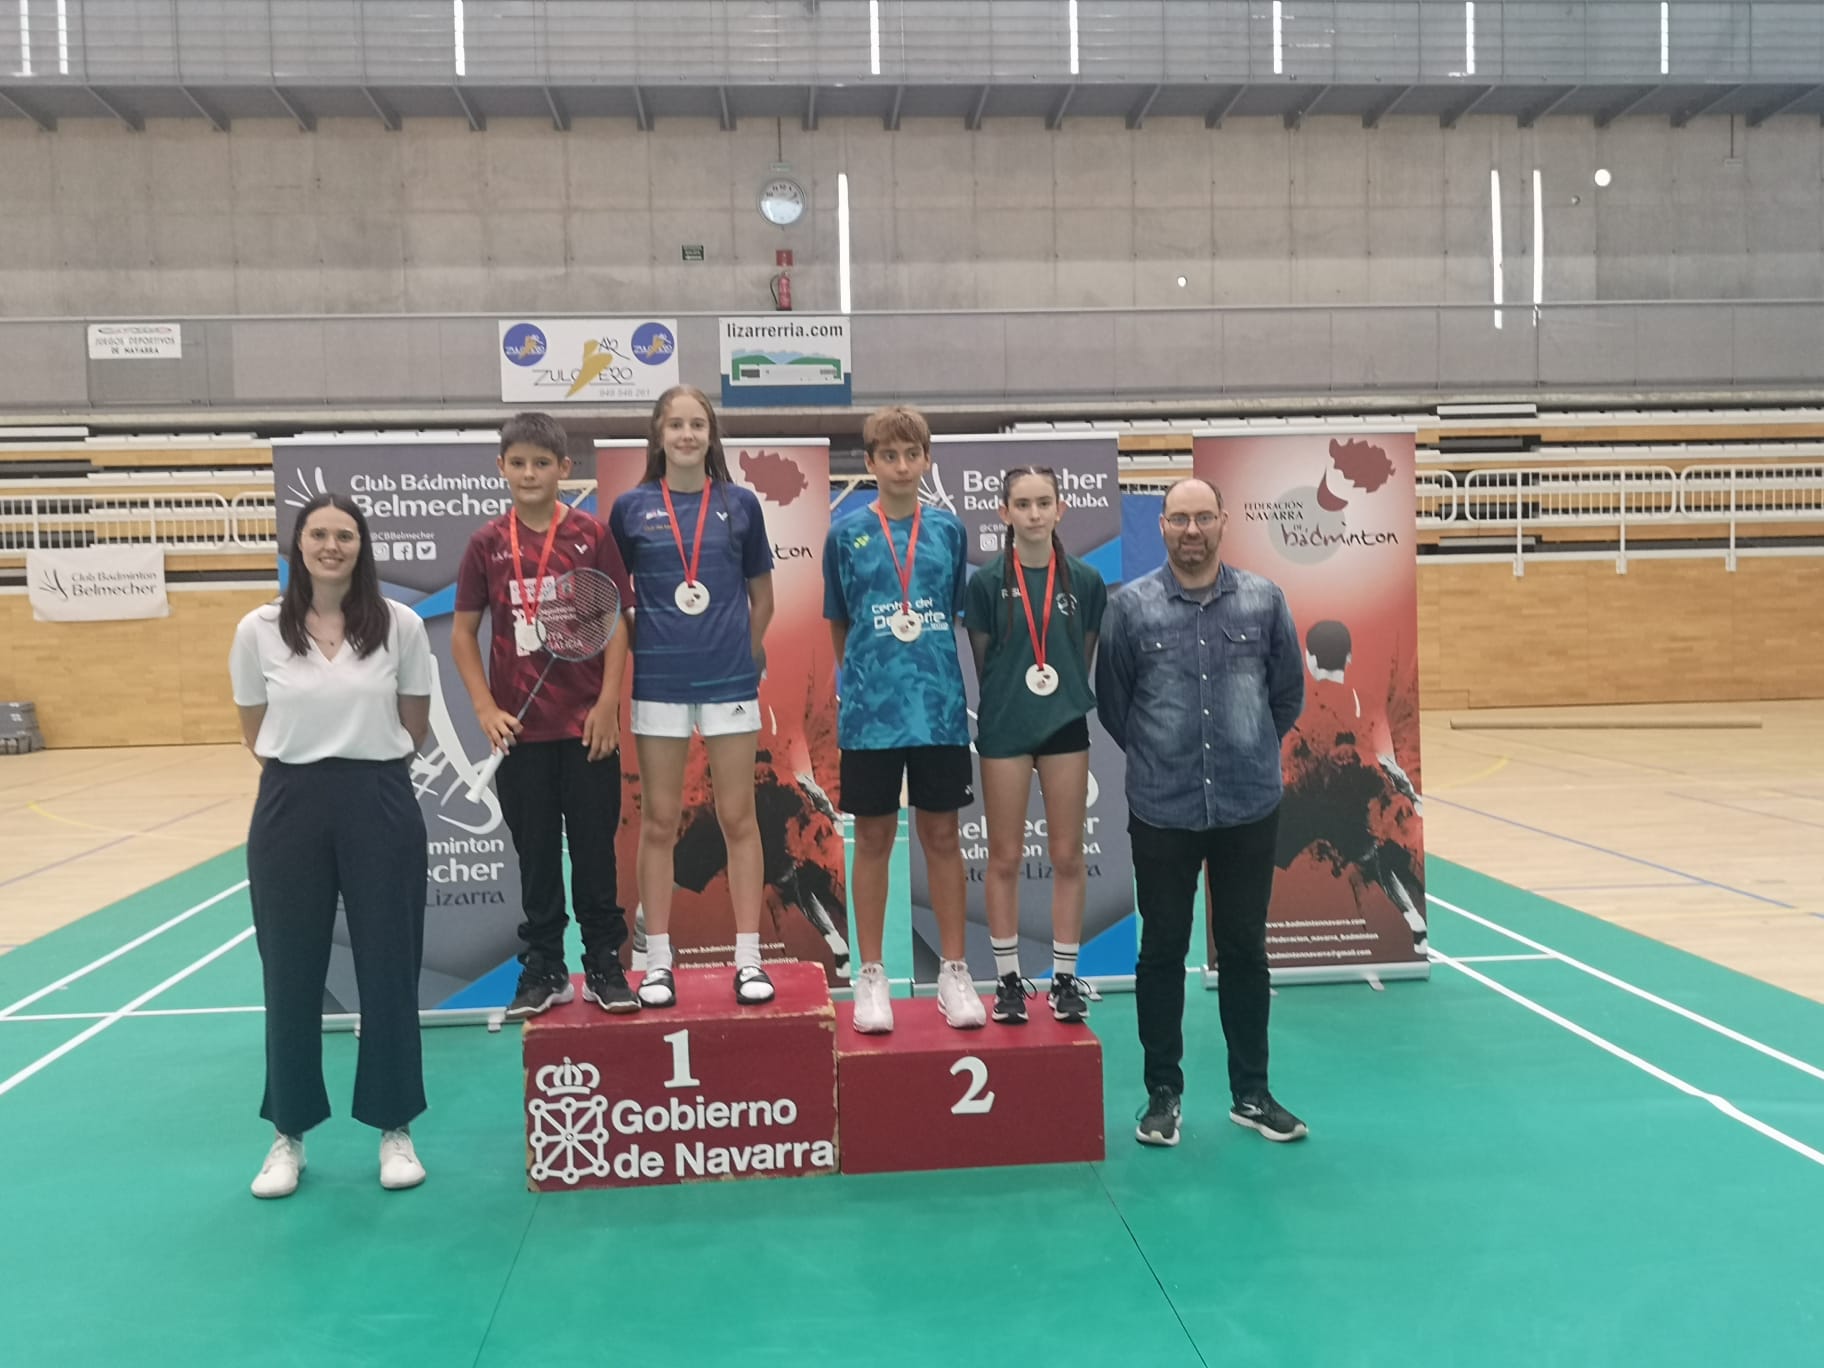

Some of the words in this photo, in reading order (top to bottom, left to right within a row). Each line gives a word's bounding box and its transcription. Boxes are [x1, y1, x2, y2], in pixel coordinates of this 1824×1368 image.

[727, 322, 843, 338] lizarrerria.com
[350, 474, 397, 491] Club
[350, 493, 513, 518] Belmecher
[1245, 511, 1304, 521] NAVARRA
[72, 571, 96, 582] Club
[72, 582, 157, 597] Belmecher
[427, 837, 505, 855] minton
[663, 1028, 701, 1088] 1
[950, 1055, 995, 1115] 2
[611, 1095, 798, 1134] Gobierno
[613, 1144, 665, 1179] de
[675, 1139, 835, 1177] Navarra
